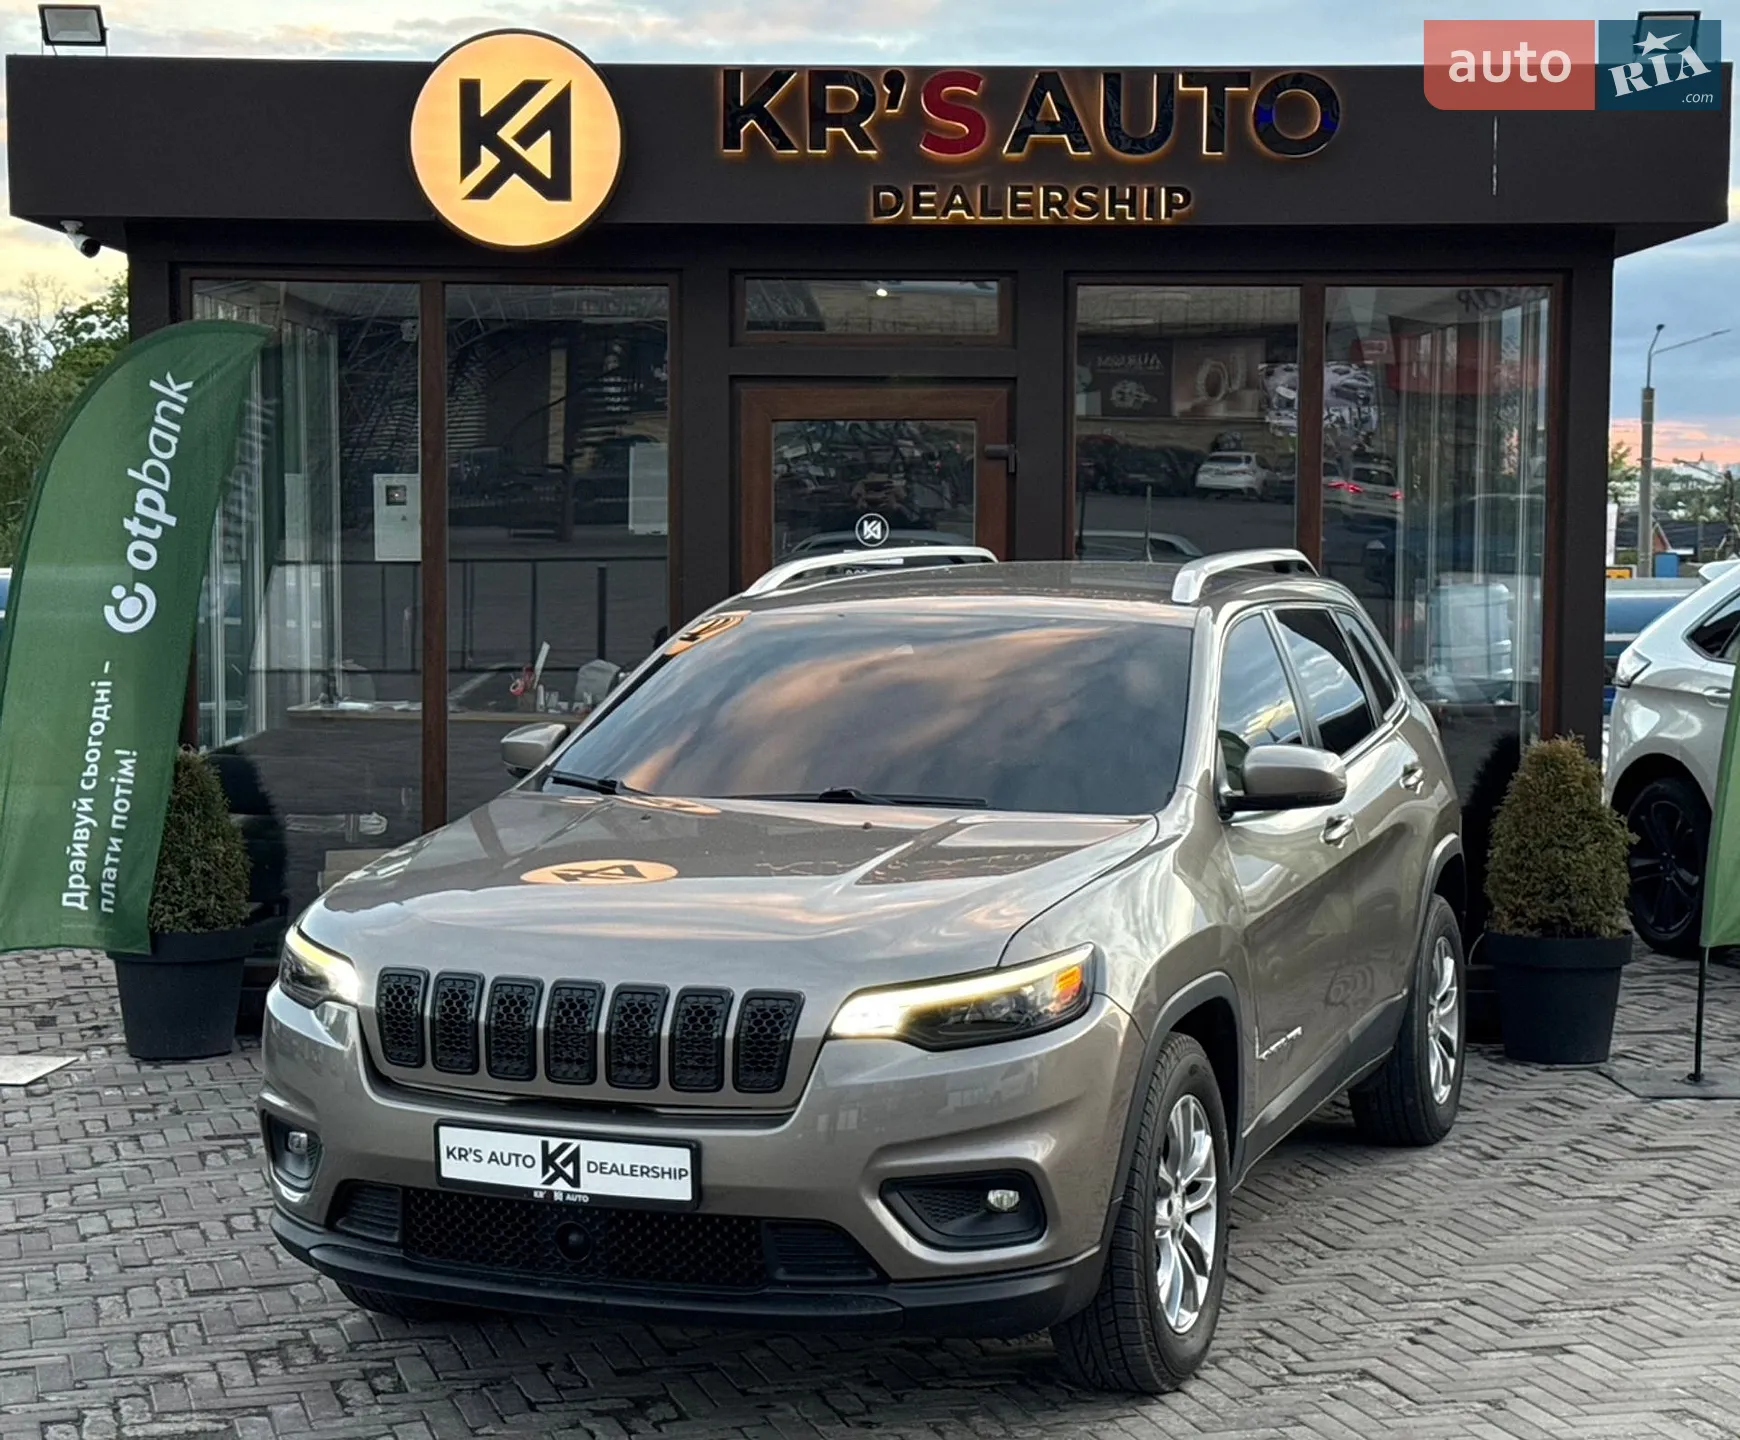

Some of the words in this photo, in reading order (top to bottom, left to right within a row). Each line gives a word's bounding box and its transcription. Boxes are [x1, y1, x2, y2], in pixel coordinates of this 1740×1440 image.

[721, 68, 988, 157] KR'S
[1002, 71, 1342, 159] AUTO
[871, 184, 1193, 221] DEALERSHIP
[126, 371, 194, 571] otpbank
[61, 797, 99, 911] Драйвуй
[80, 680, 113, 791] сьогодні
[109, 748, 138, 830] потім!
[100, 838, 124, 914] плати
[445, 1145, 484, 1164] KR'S
[487, 1150, 537, 1169] AUTO
[586, 1160, 690, 1181] DEALERSHIP
[565, 1193, 590, 1203] AUTO
